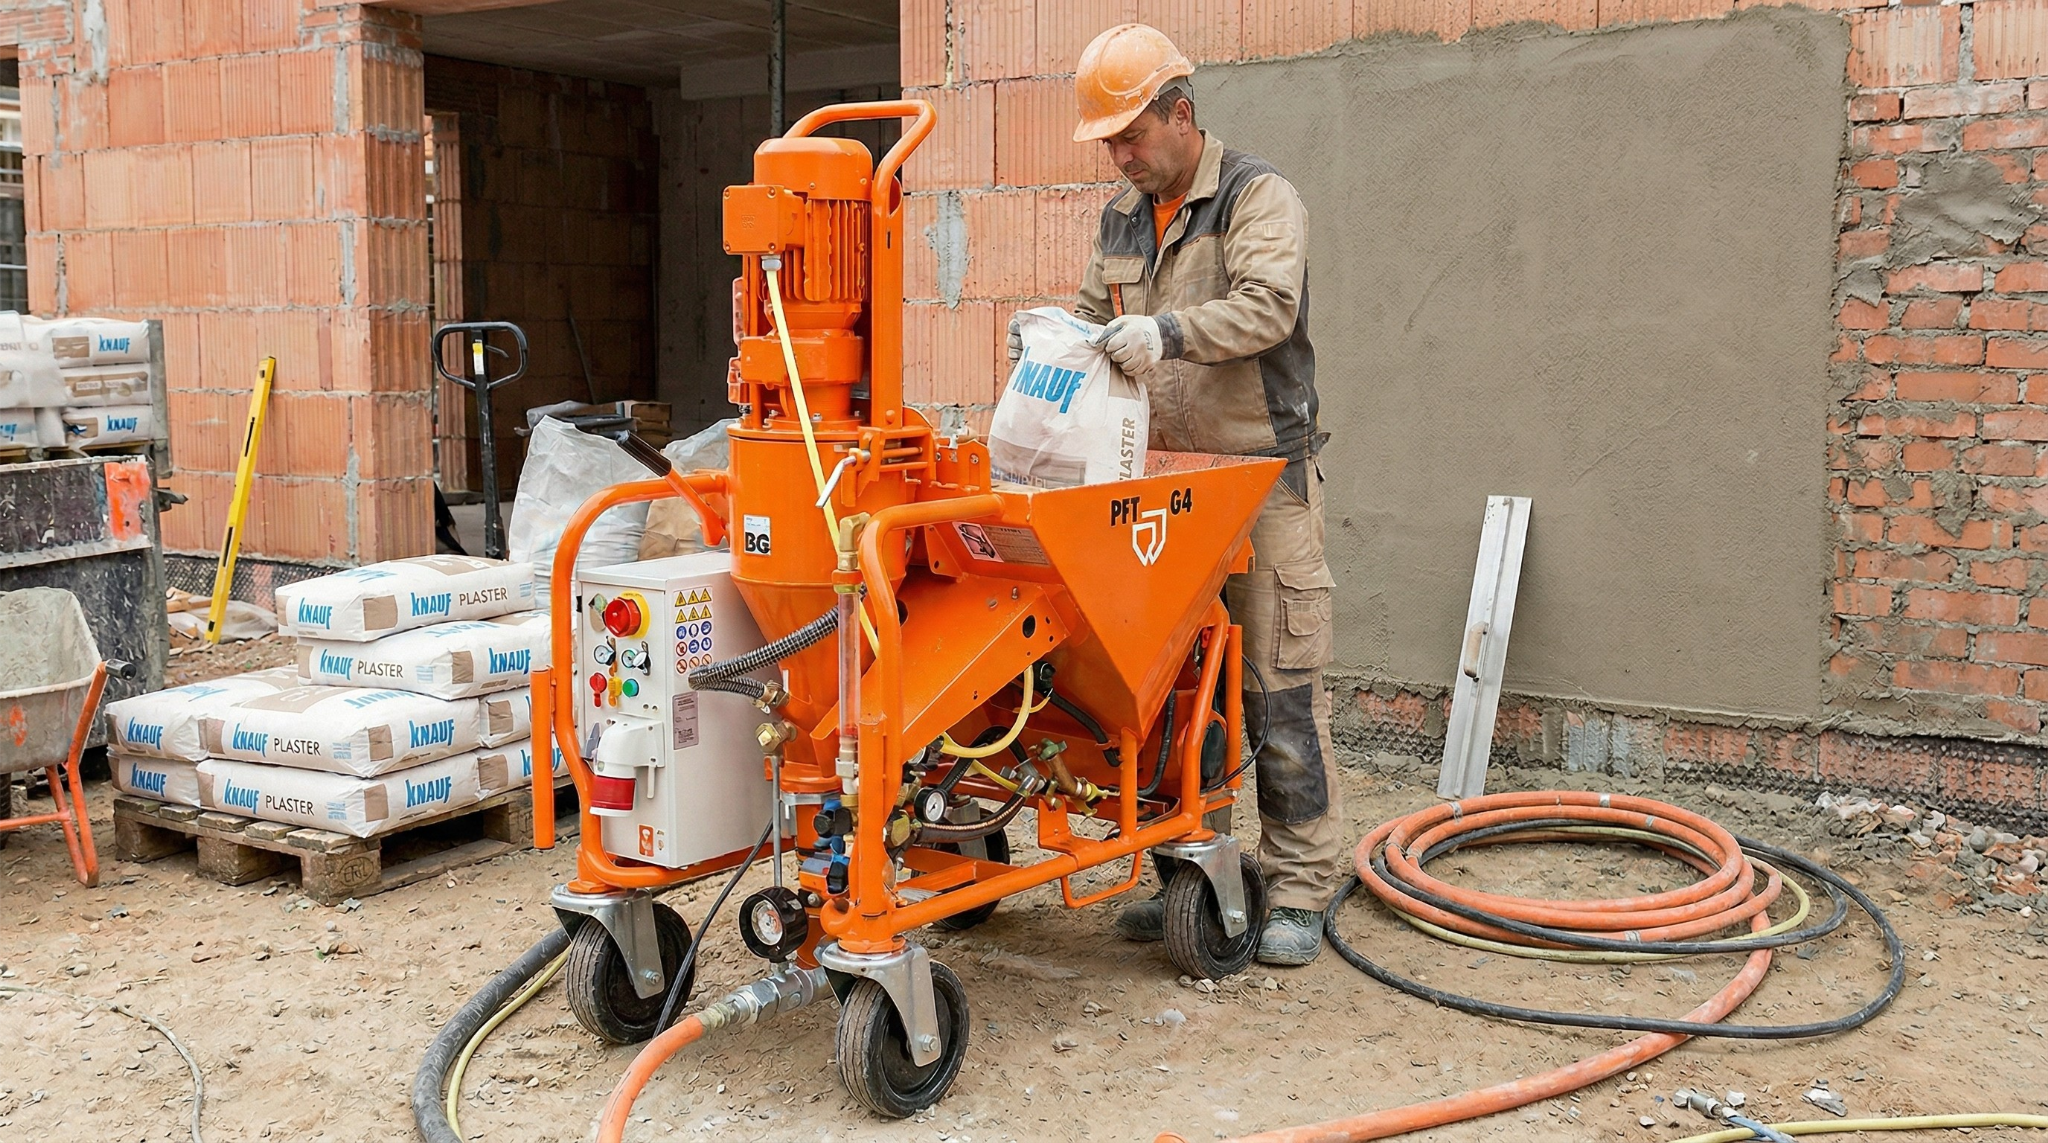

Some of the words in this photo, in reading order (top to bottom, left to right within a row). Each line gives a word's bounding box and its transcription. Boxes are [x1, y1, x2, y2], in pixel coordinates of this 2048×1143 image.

[1119, 417, 1135, 480] LASTER
[1110, 497, 1140, 527] PFT
[1170, 487, 1193, 515] G4
[745, 532, 770, 553] BG
[299, 597, 332, 629] KNAUF
[410, 592, 452, 616] KNAUF
[459, 587, 508, 606] PLASTER
[319, 649, 354, 680] KNAUF
[357, 660, 403, 678] PLASTER
[489, 648, 531, 675] KNAUF
[128, 717, 163, 750] KNAUF
[233, 723, 268, 757] KNAUF
[274, 738, 321, 755] PLASTER
[409, 719, 455, 748] KNAUF
[131, 763, 167, 797] KNAUF
[405, 777, 452, 808] KNAUF
[225, 779, 260, 814] KNAUF
[266, 795, 315, 816] PLASTER
